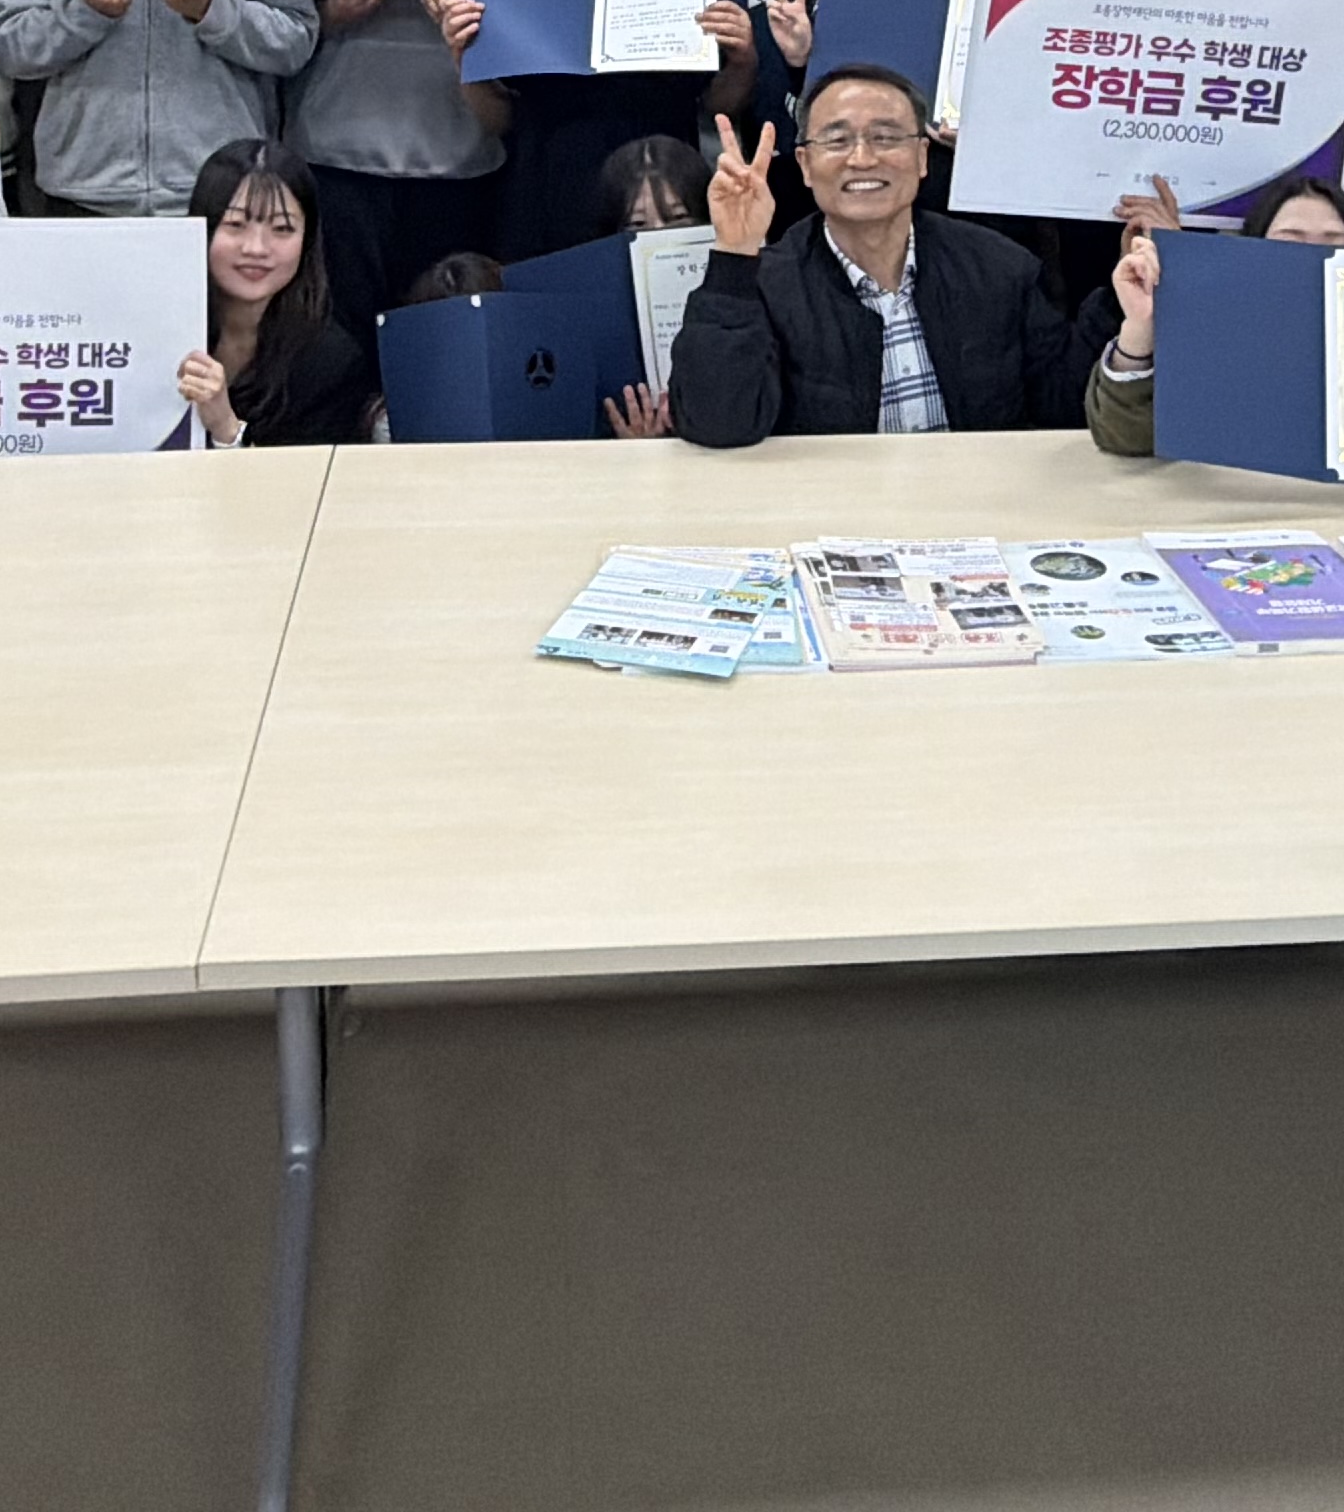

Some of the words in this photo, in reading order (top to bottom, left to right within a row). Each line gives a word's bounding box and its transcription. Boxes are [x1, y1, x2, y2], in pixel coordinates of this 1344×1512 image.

[1042, 27, 1143, 59] 조종평가
[1147, 37, 1196, 64] 우수
[1203, 40, 1251, 68] 학생
[1257, 45, 1308, 73] 대상
[1051, 63, 1186, 117] 장학금
[1195, 76, 1287, 125] 후원
[1103, 119, 1224, 146] (2,300,000원)
[16, 343, 70, 370] 학생
[77, 342, 131, 369] 대상
[18, 378, 114, 427] 후원
